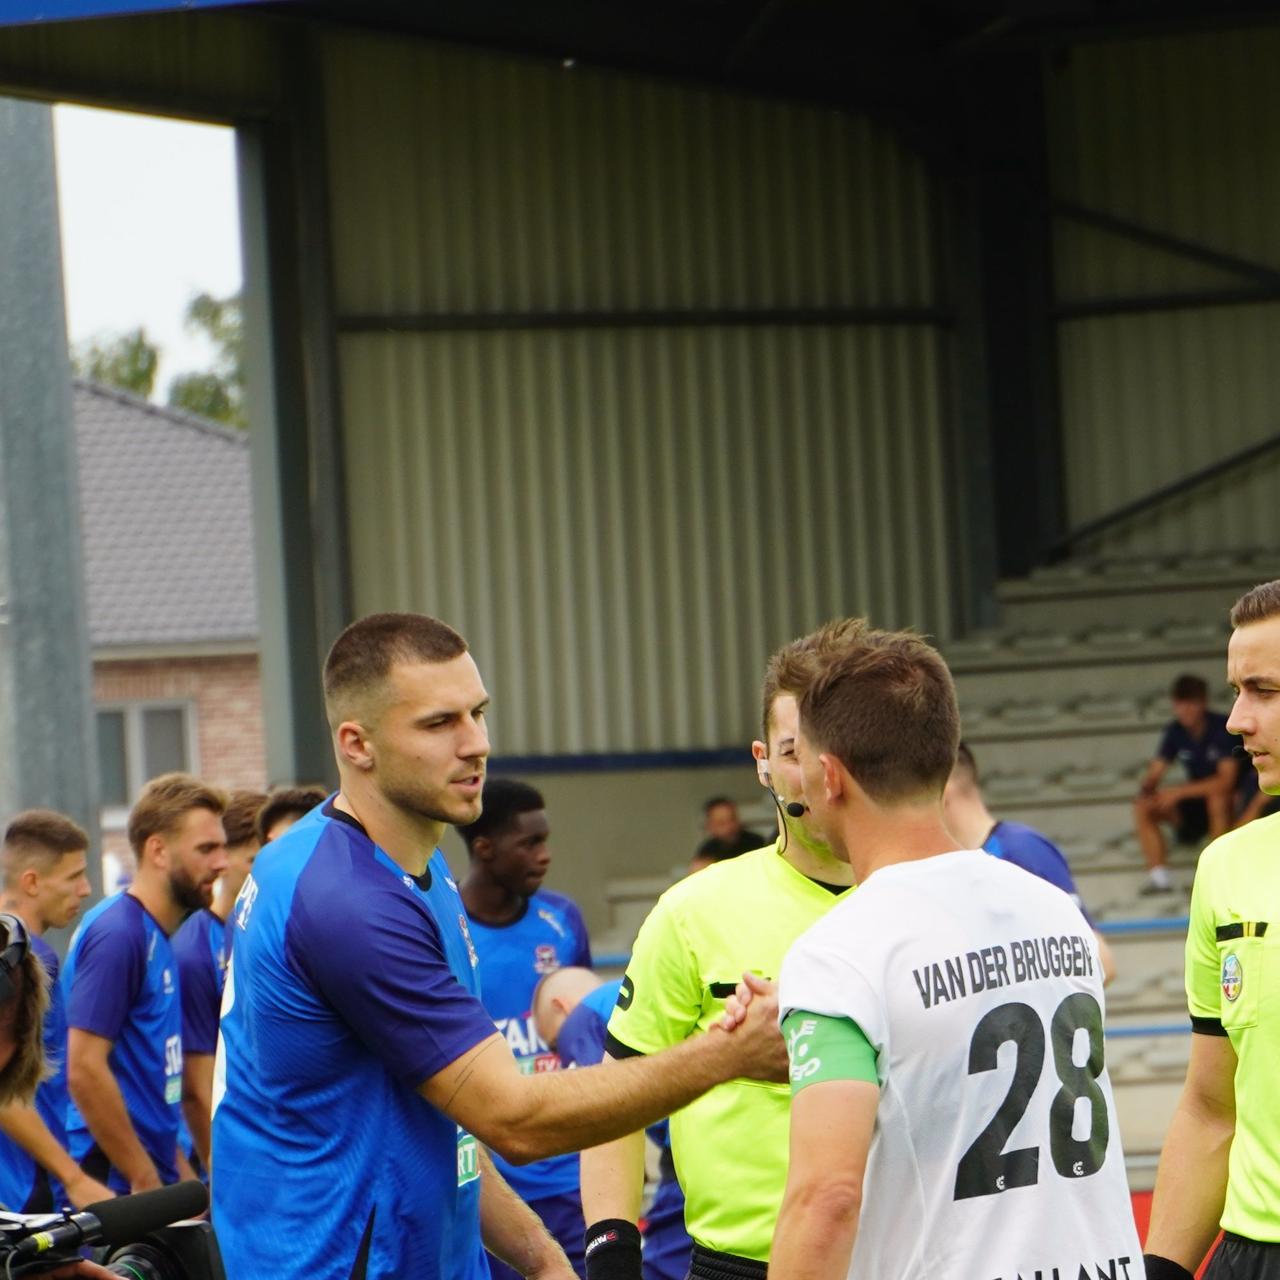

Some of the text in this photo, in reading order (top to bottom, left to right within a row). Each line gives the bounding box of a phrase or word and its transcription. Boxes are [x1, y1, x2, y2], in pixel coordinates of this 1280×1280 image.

[912, 936, 1093, 1009] VAN DER BRUGGEN
[954, 992, 1109, 1201] 28
